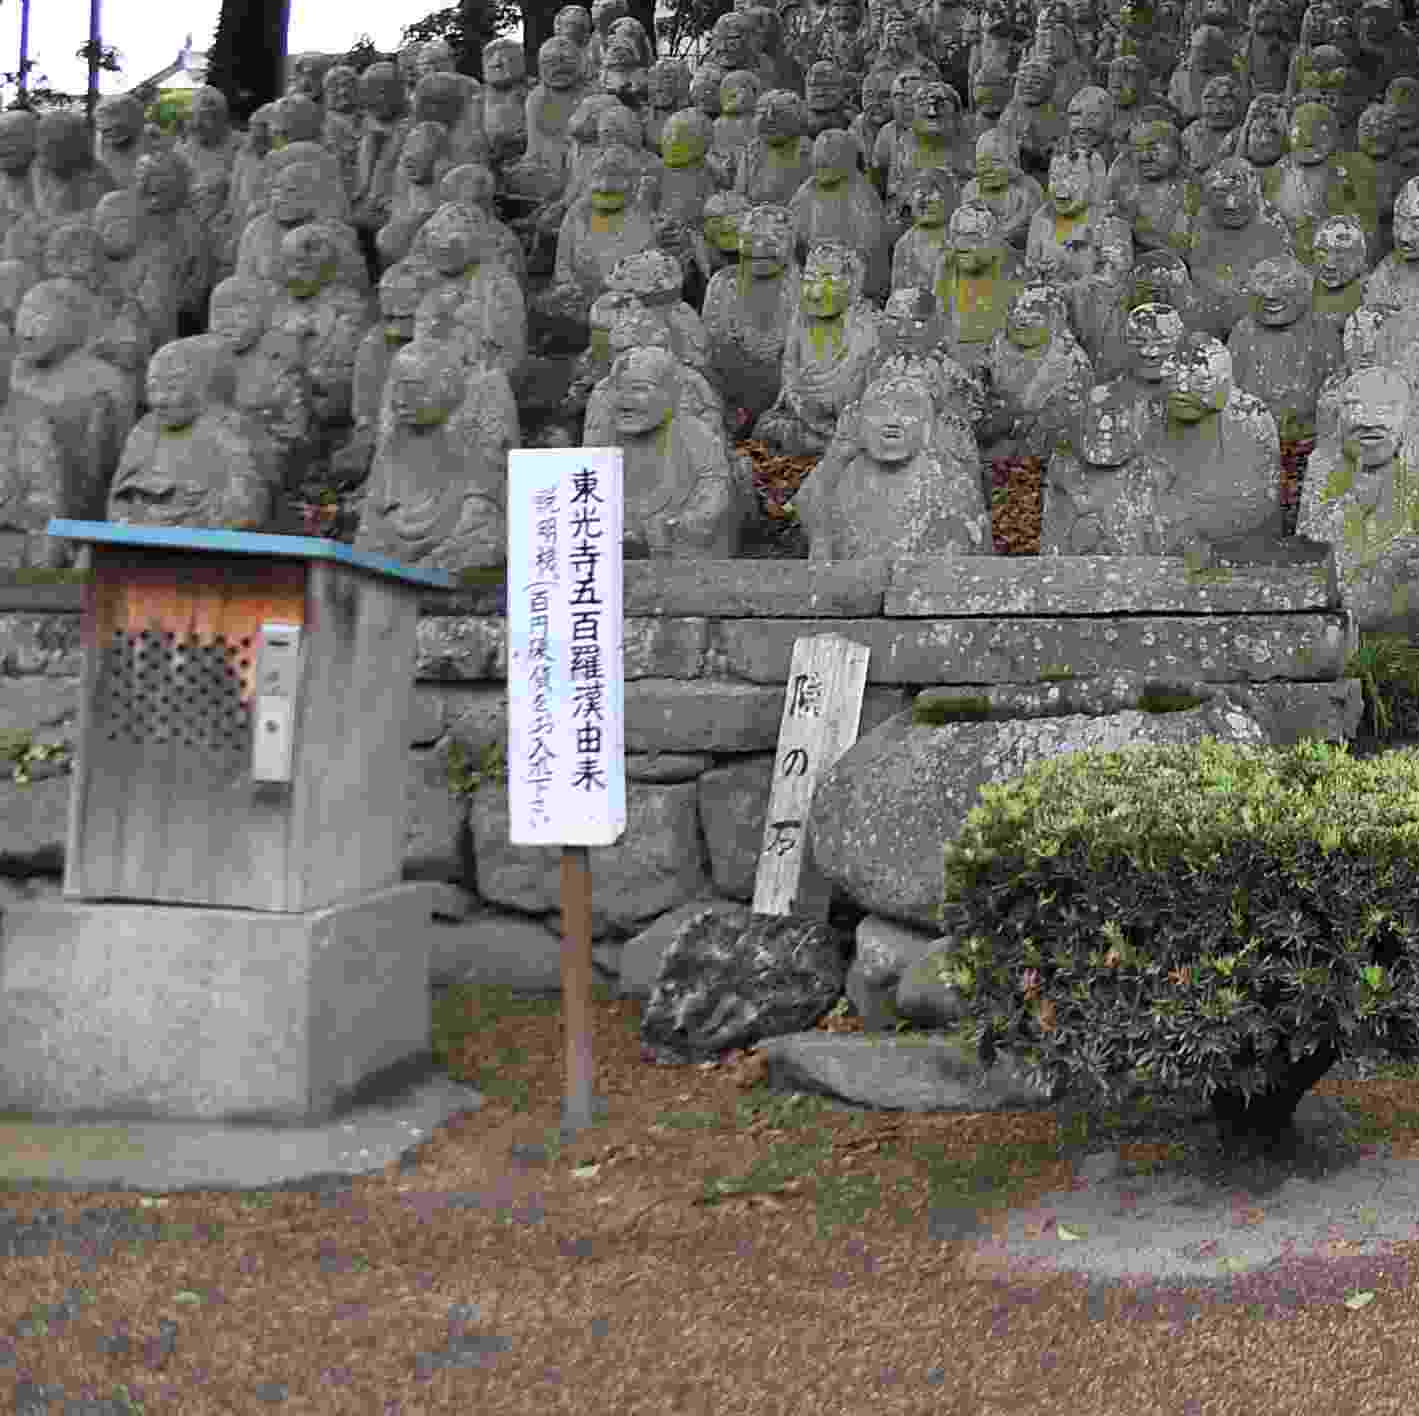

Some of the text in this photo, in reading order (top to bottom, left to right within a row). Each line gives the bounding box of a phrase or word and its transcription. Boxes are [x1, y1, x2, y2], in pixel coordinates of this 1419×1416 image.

[568, 468, 607, 792] 東光寺五百羅漢由来
